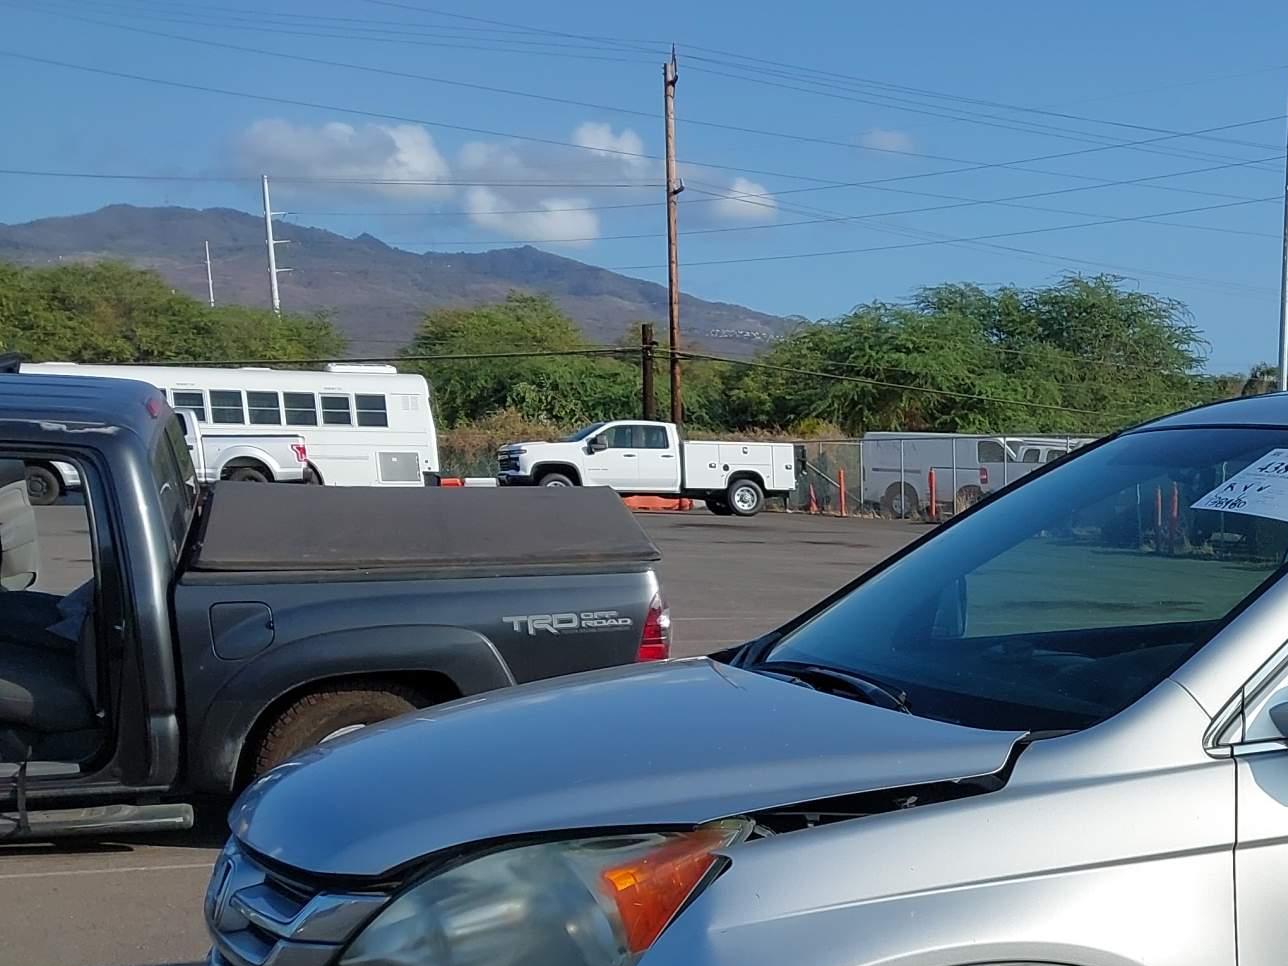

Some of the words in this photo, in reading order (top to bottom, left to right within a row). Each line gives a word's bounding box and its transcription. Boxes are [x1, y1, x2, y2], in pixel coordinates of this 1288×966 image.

[580, 611, 618, 619] OFF
[502, 613, 577, 636] TRD
[581, 618, 632, 627] ROAD
